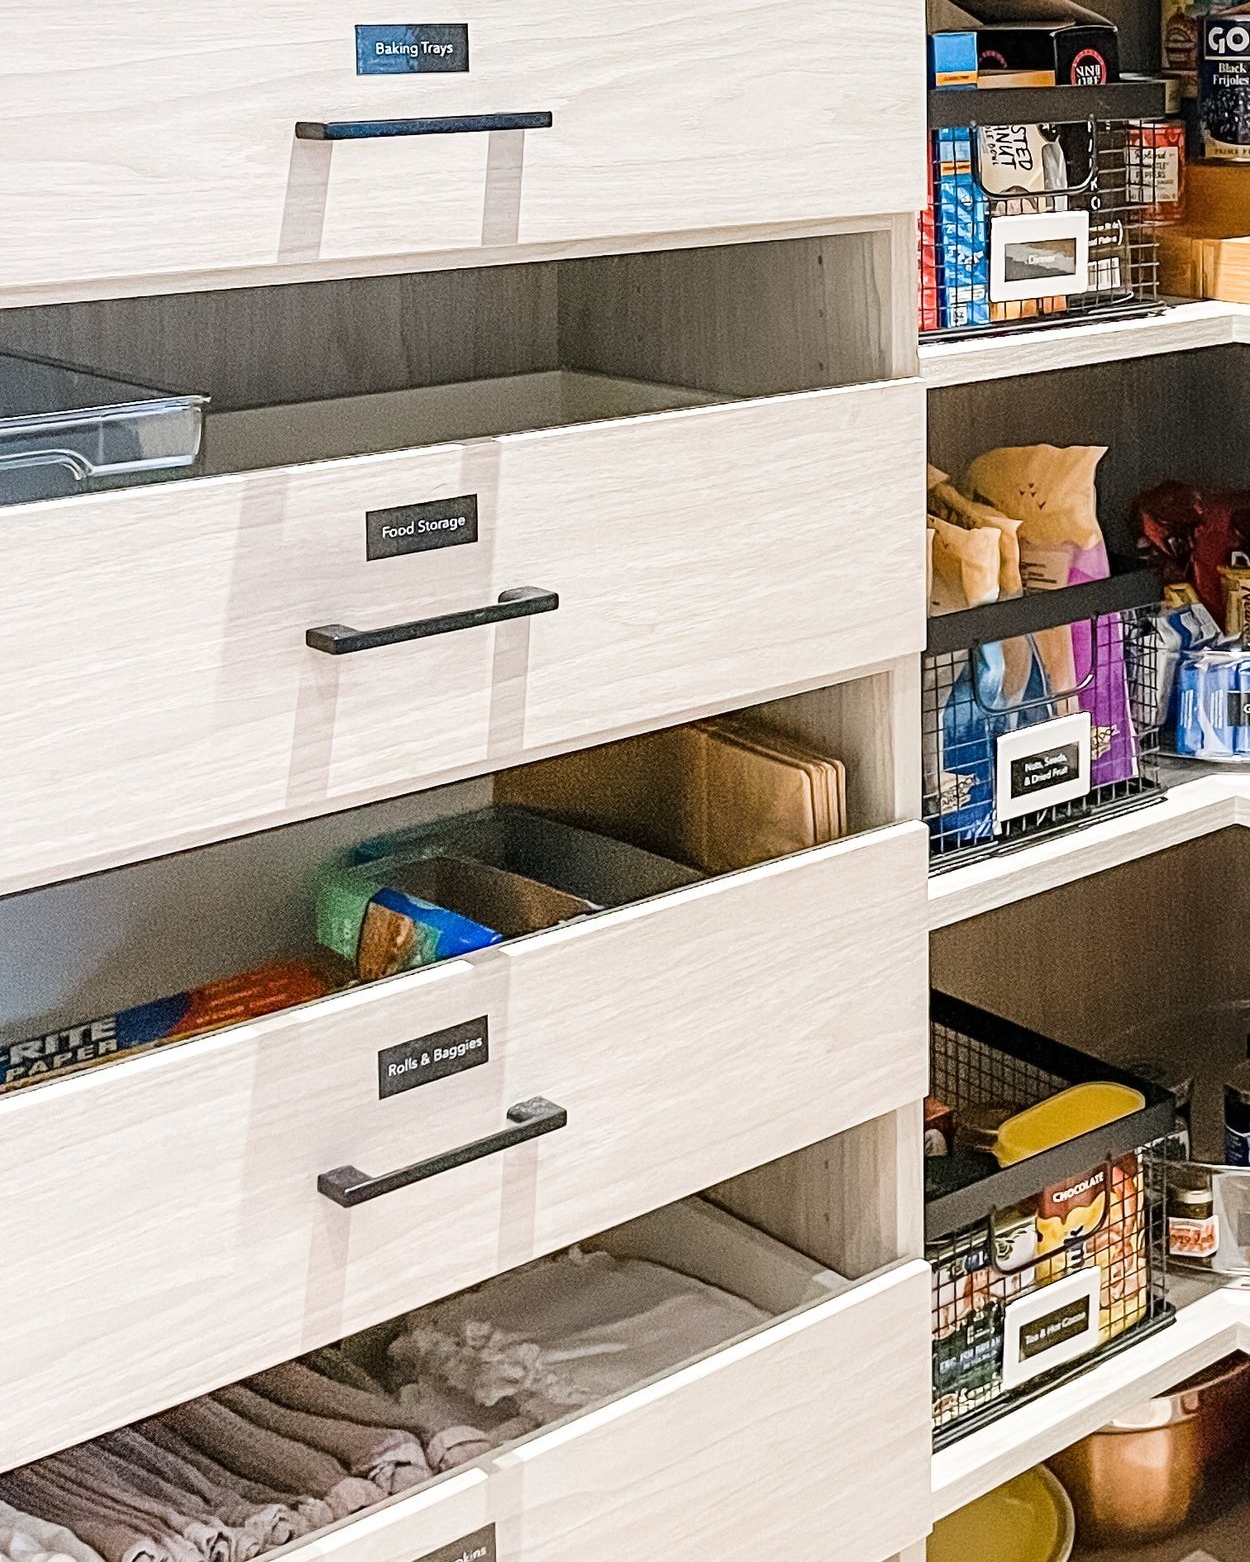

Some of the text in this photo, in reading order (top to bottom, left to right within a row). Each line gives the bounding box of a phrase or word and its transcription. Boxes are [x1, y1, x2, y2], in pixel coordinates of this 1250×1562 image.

[374, 39, 455, 58] Baking Trays
[1218, 62, 1246, 74] Black
[1212, 74, 1250, 87] Frijoles
[1028, 255, 1057, 265] Dinner
[381, 512, 467, 540] Food Storage
[1024, 766, 1069, 787] & Dried Fruit
[5, 1038, 118, 1082] PAPER
[388, 1034, 484, 1078] Rolls & Baggies
[1052, 1171, 1105, 1204] CHOCOLATE
